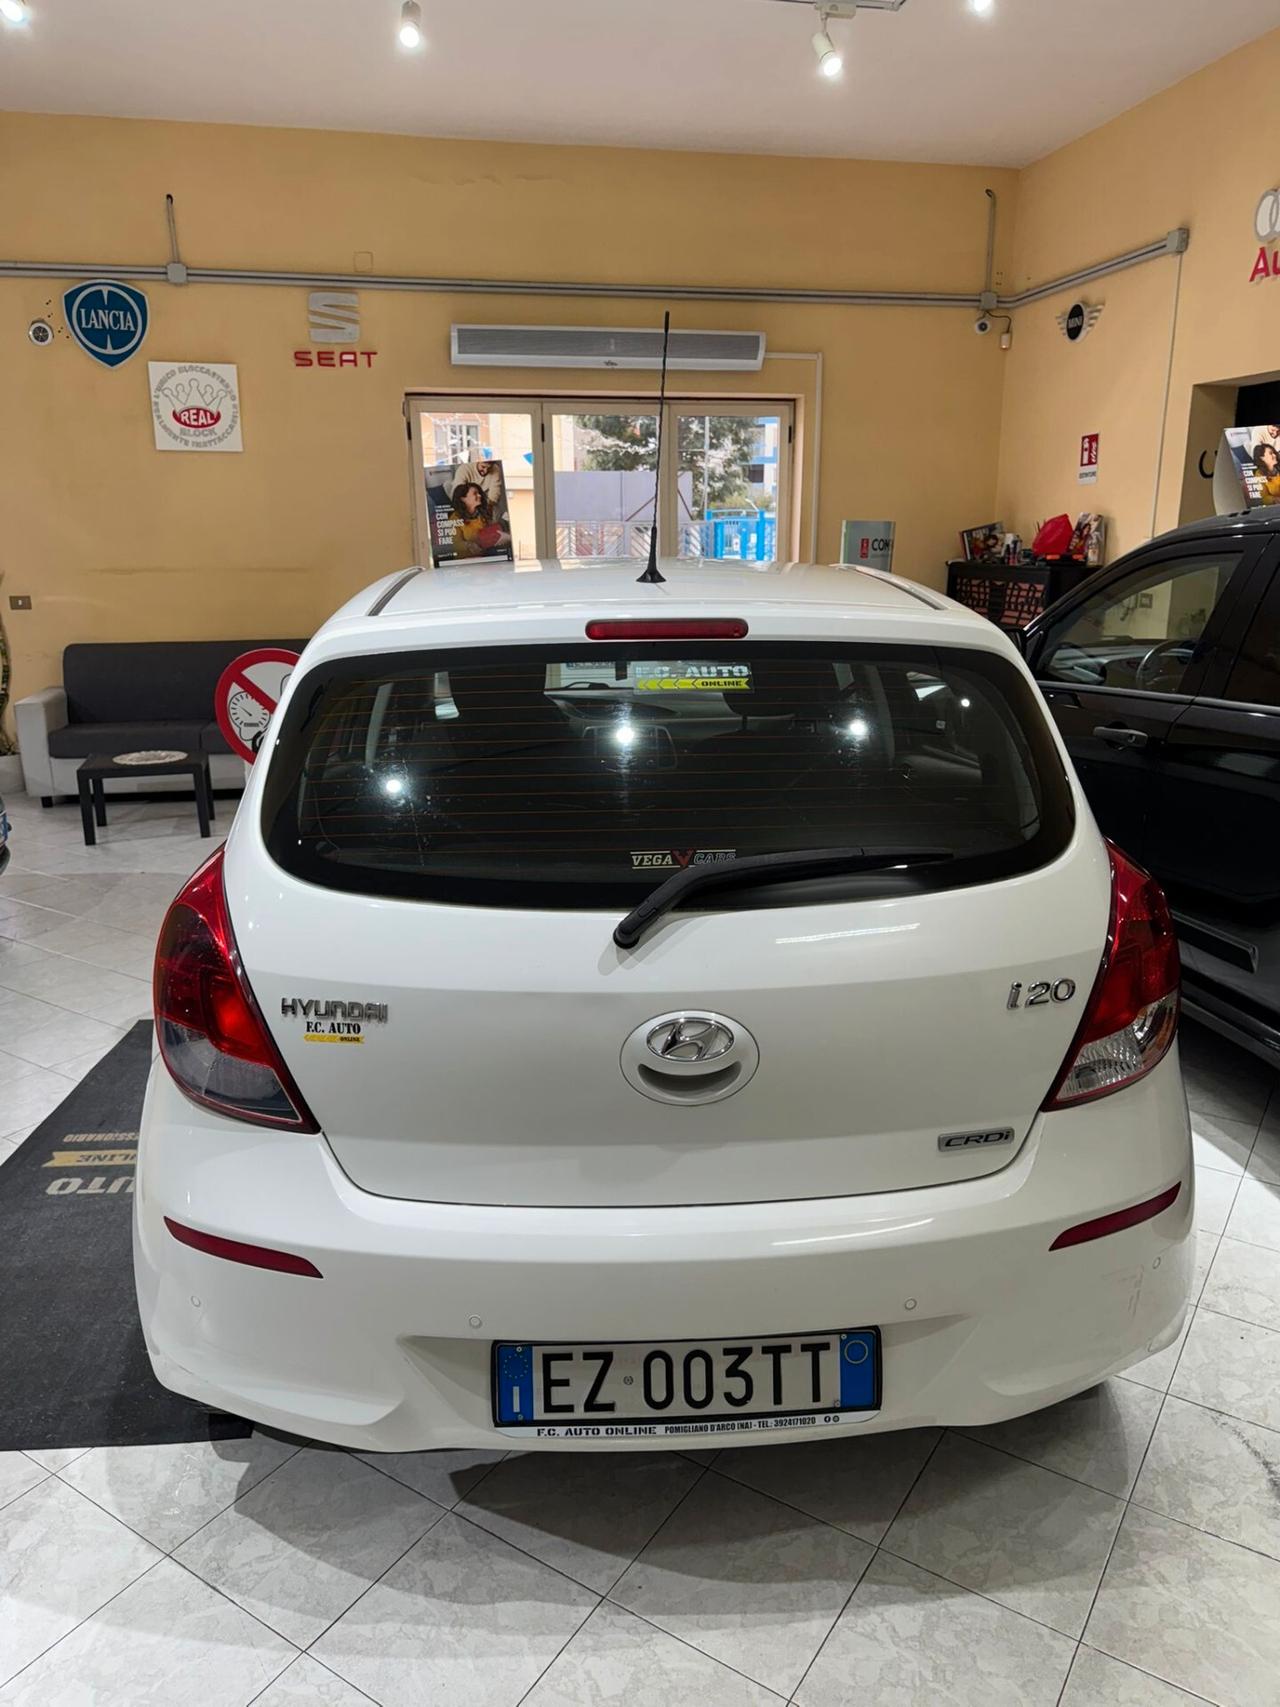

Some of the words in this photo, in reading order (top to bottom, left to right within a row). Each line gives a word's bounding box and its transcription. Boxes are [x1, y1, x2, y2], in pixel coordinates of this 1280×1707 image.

[80, 308, 136, 331] LANCIA
[1068, 315, 1083, 328] MINI
[294, 351, 378, 368] SEAT
[180, 409, 216, 427] REAL
[179, 428, 218, 438] BLOCK
[437, 519, 465, 529] COMPASS
[437, 529, 444, 537] SI
[438, 537, 453, 545] FARE
[685, 665, 750, 677] AUTO
[632, 854, 673, 866] VEGA
[1007, 978, 1076, 1010] i20
[281, 998, 388, 1022] HYUNDAI
[306, 1021, 325, 1033] F.C.
[329, 1022, 361, 1034] AUTO
[944, 1131, 1011, 1147] CRDi
[542, 1351, 615, 1413] EZ
[643, 1342, 831, 1411] 003TT
[536, 1428, 560, 1437] F.C.
[565, 1427, 601, 1436] AUTO
[605, 1426, 657, 1436] ONLINE
[665, 1423, 710, 1434] POMIGLIANO
[710, 1421, 736, 1432] D'ARCO
[774, 1416, 816, 1427] 3924171020
